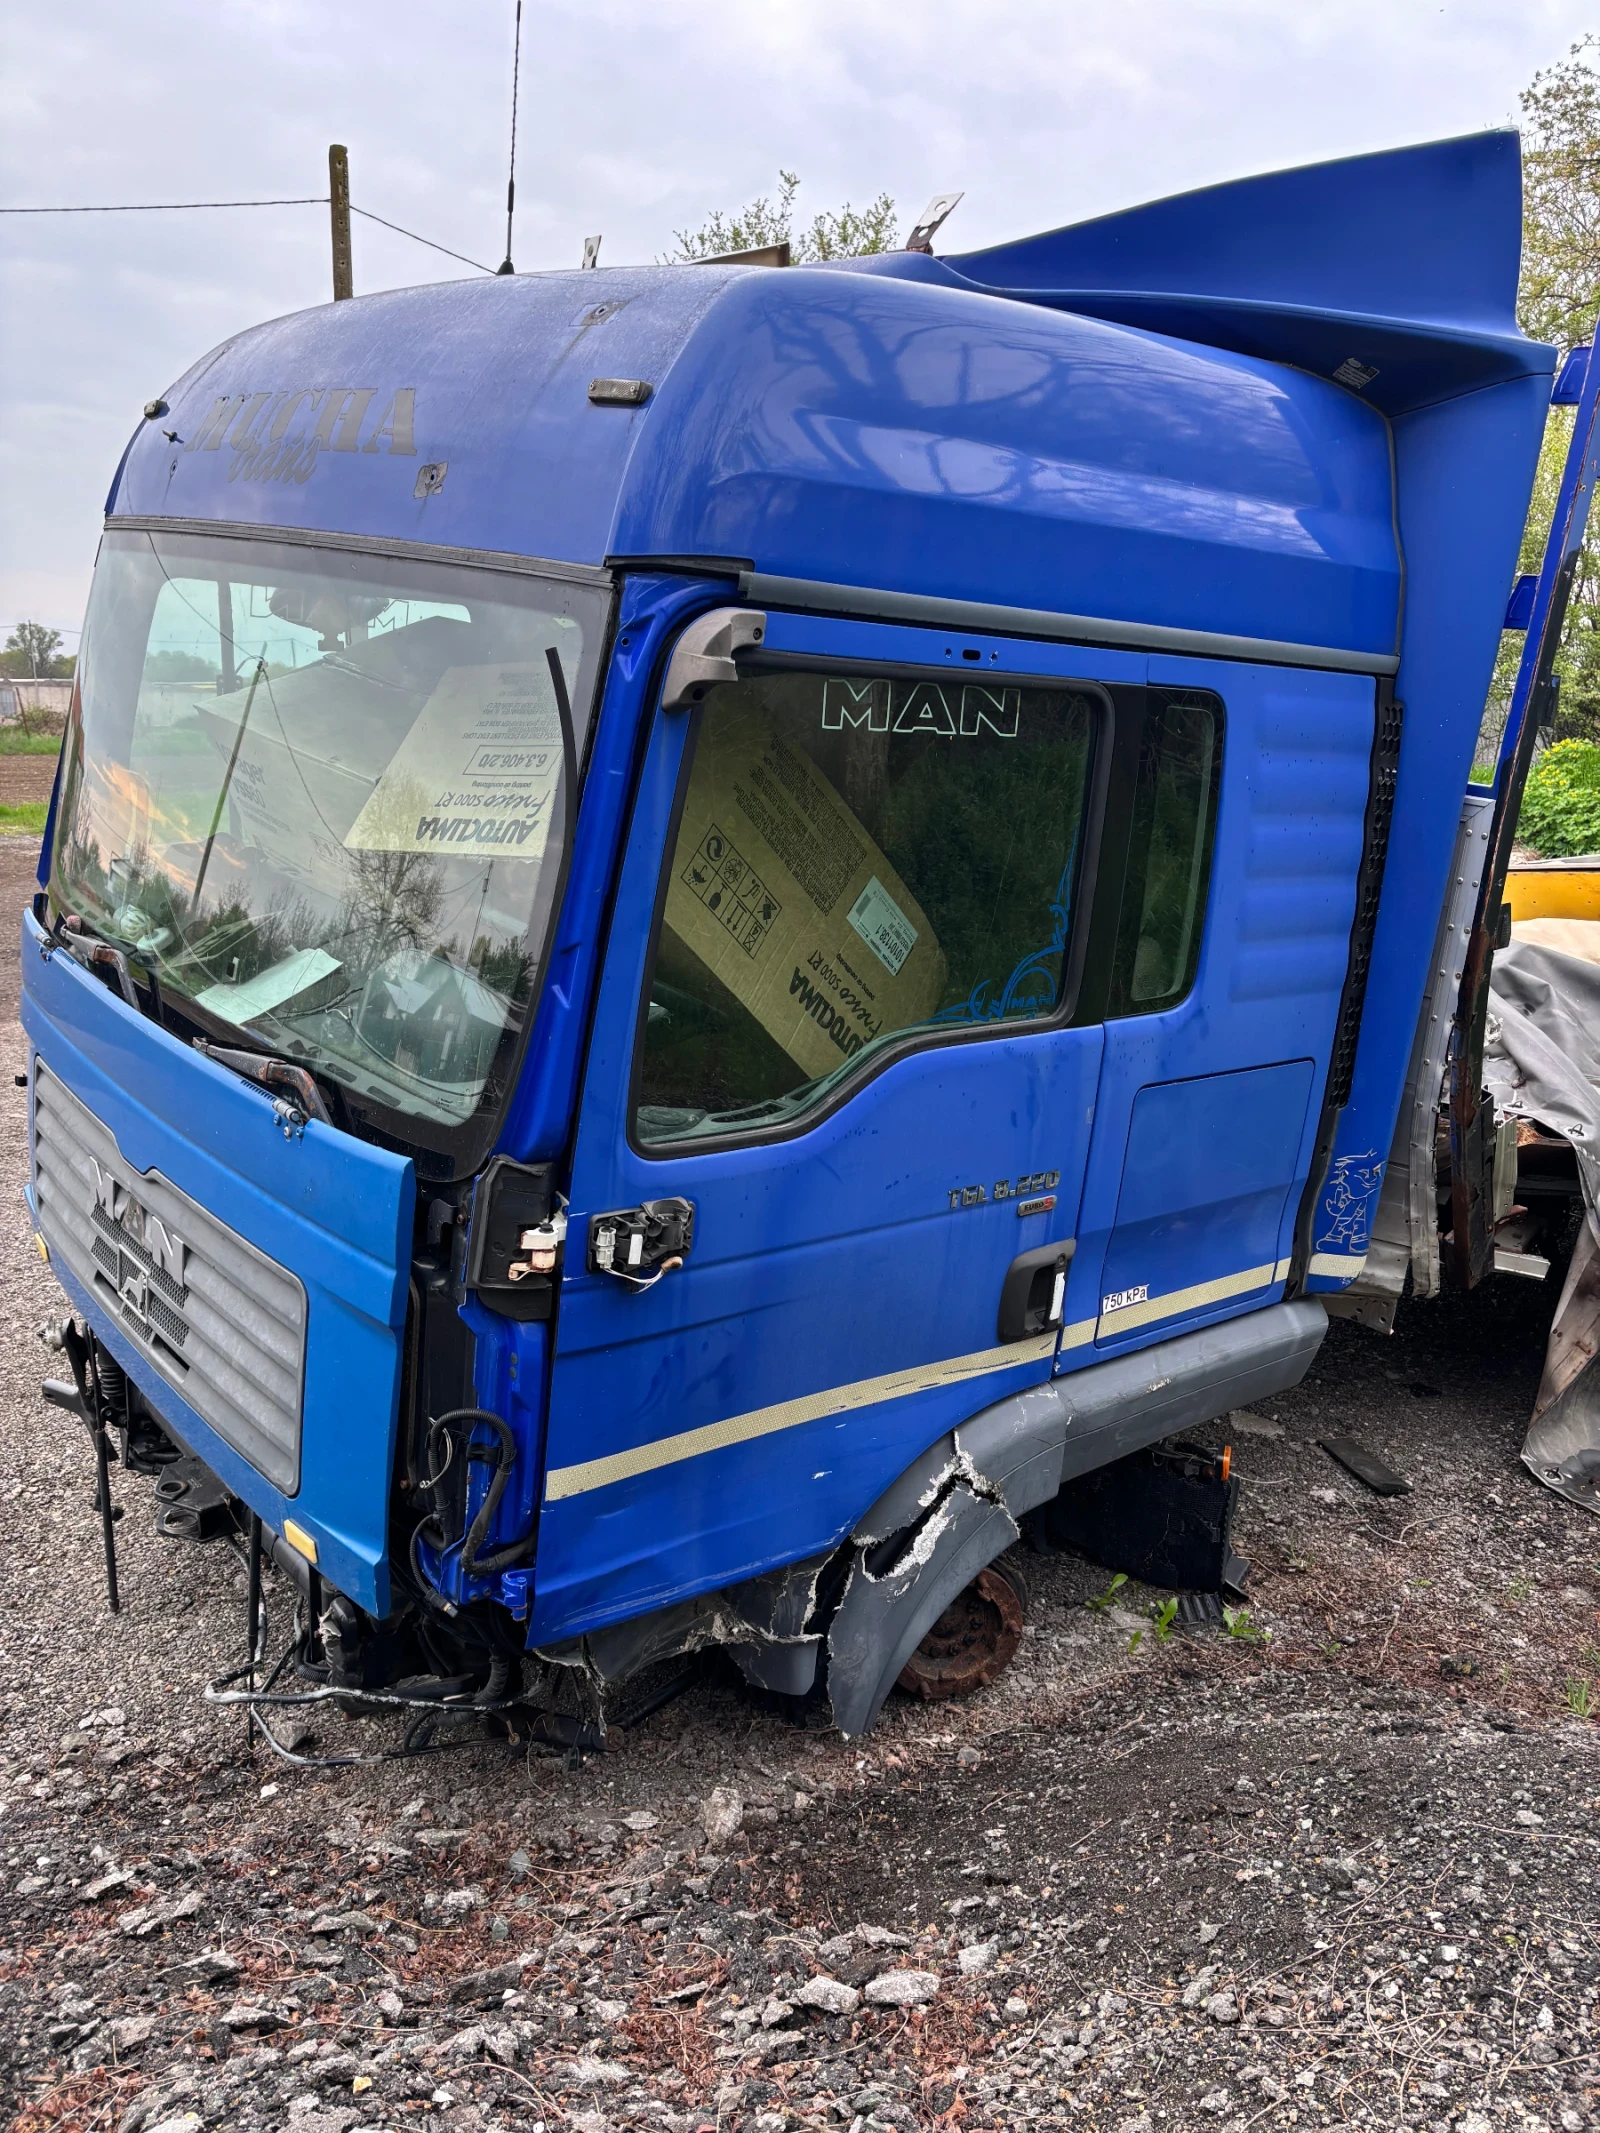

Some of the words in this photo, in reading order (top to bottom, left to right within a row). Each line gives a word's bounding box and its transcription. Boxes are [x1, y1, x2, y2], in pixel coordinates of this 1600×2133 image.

[822, 679, 1021, 737] MAN
[472, 780, 504, 788] conditioning
[434, 791, 451, 807] RT
[454, 794, 482, 806] 5000
[484, 789, 551, 819] Fresco
[415, 816, 540, 844] AUTOCLIMA
[807, 949, 825, 971] RT
[820, 964, 842, 991] 5000
[790, 966, 864, 1058] UTOCLIMA
[948, 1185, 989, 1208] TGL
[994, 1169, 1060, 1200] 8.220
[1104, 1293, 1123, 1310] 750
[1126, 1287, 1146, 1303] kPa
